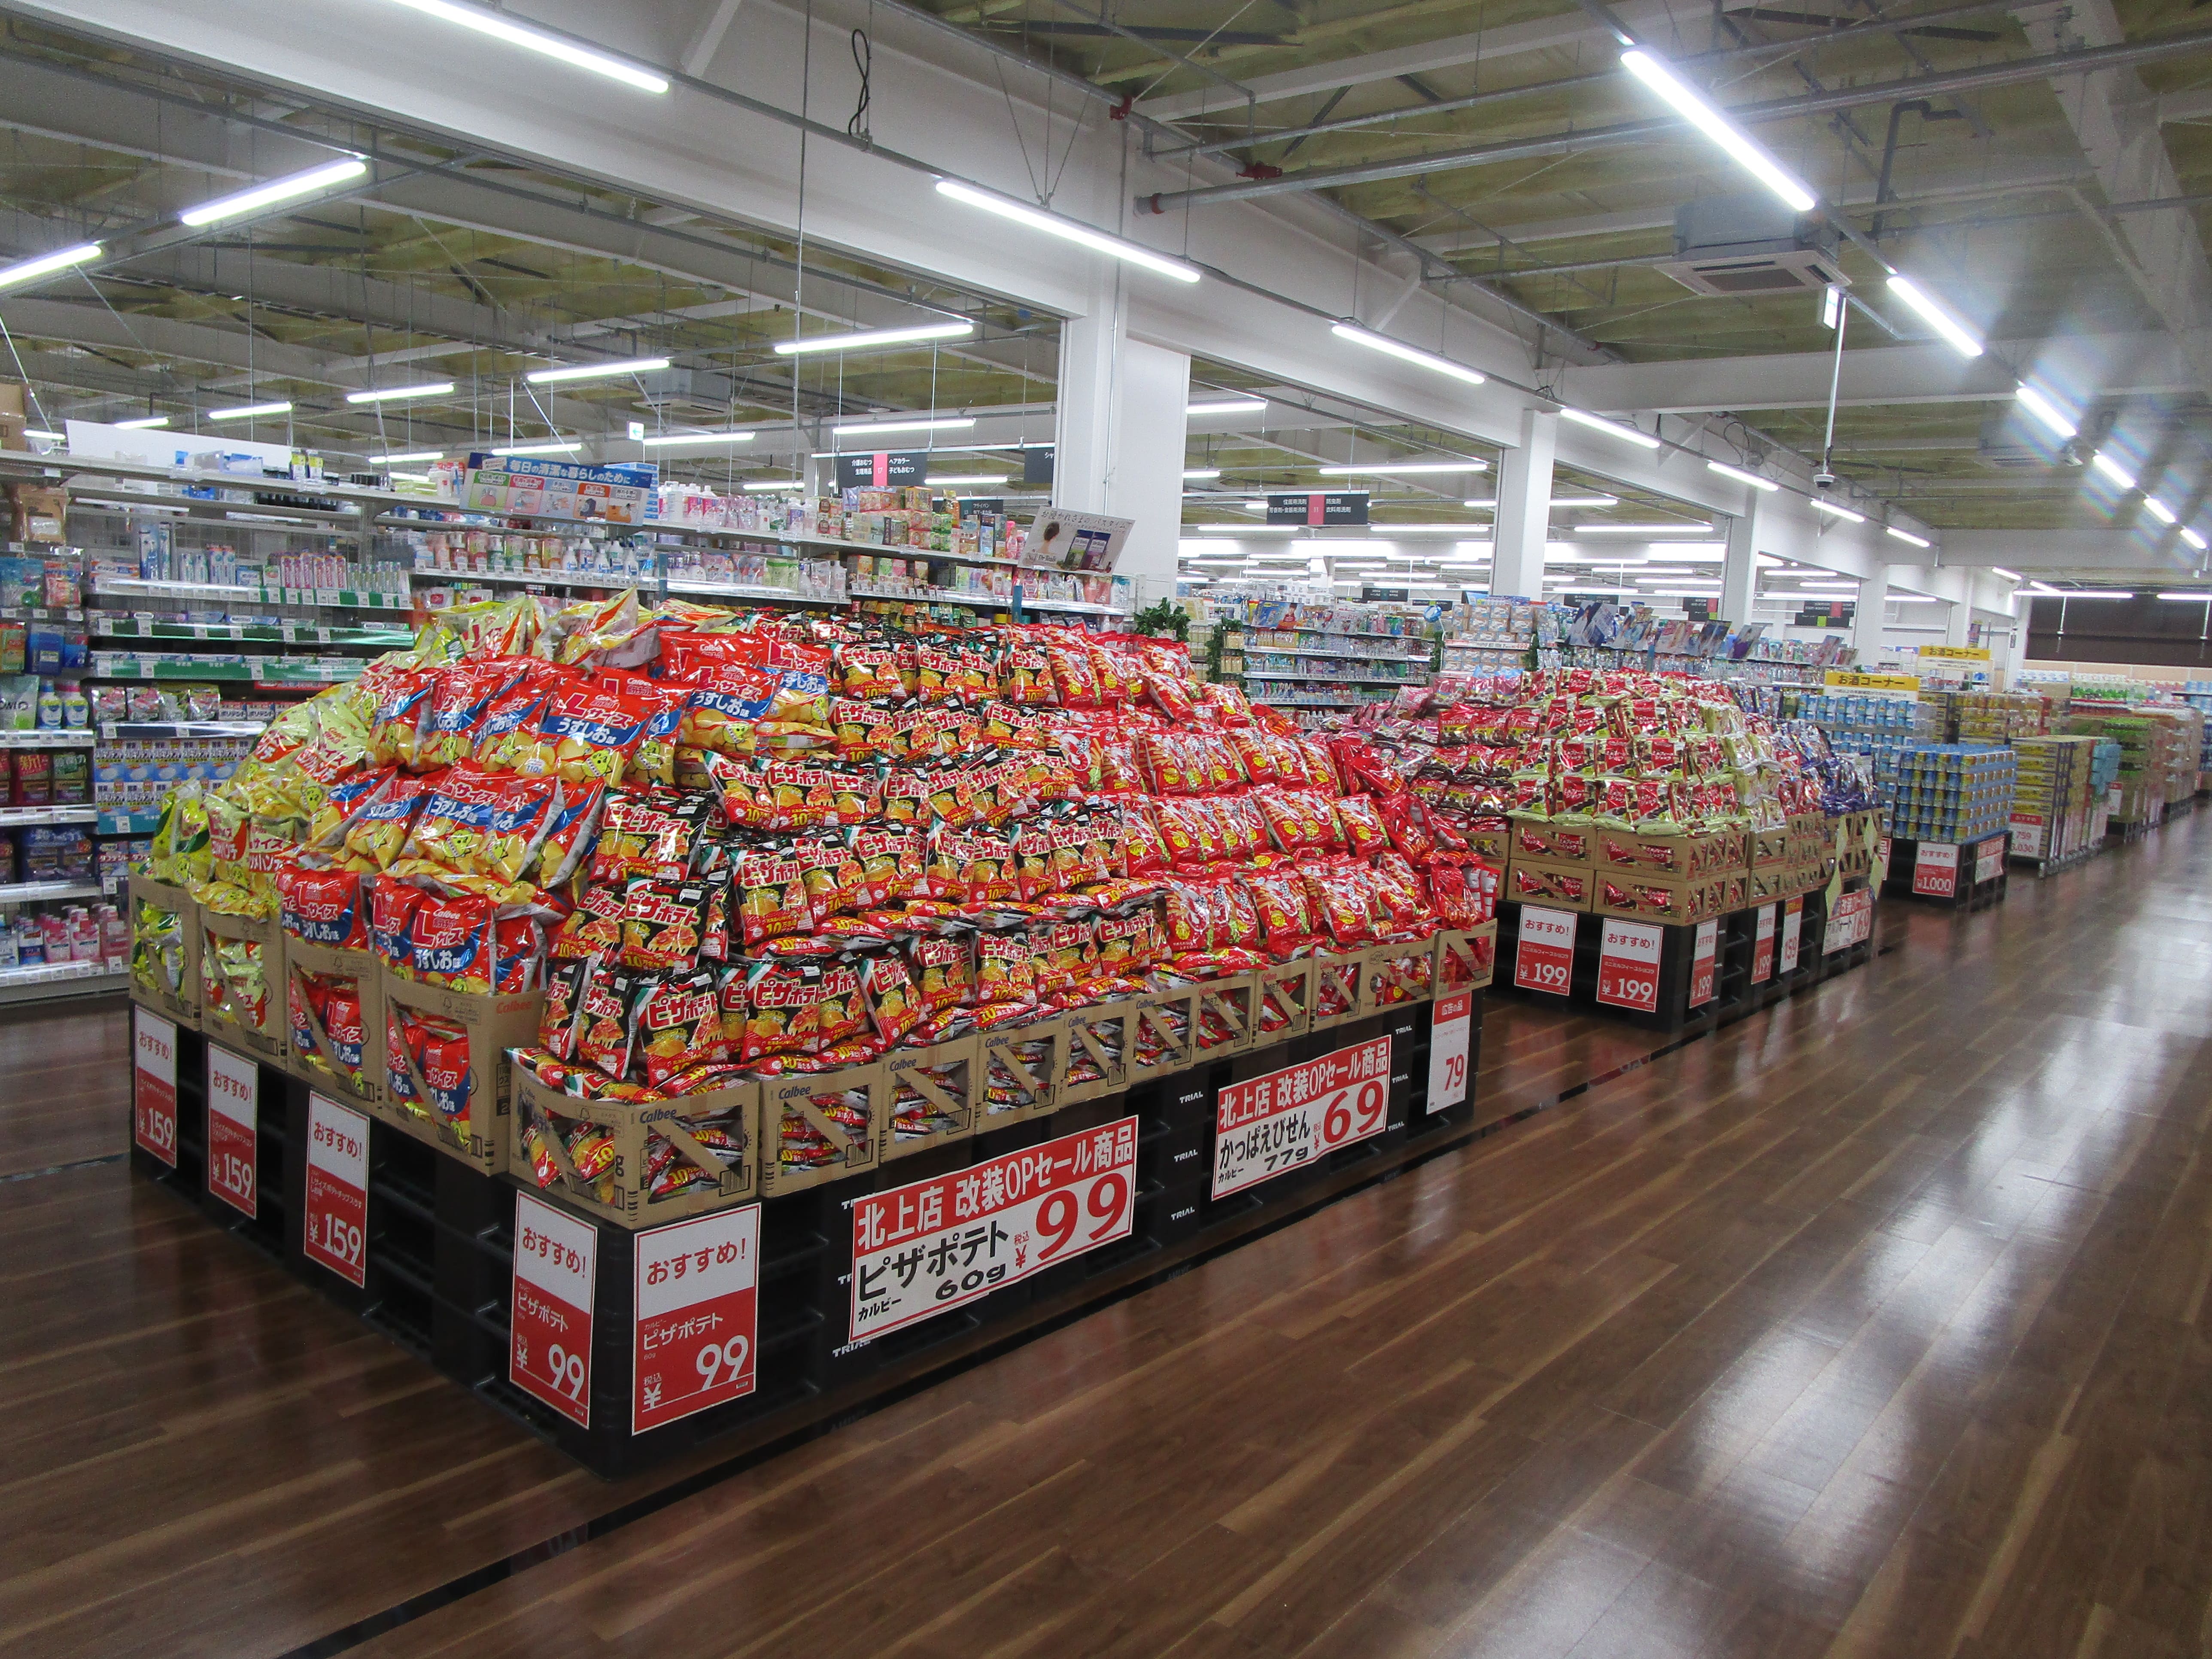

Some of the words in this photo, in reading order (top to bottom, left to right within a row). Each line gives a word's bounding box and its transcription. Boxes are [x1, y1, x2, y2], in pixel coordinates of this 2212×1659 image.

[889, 466, 915, 474] 子どもおむつ
[1839, 675, 1905, 687] お酒コーナー
[694, 691, 750, 718] うすしお味
[835, 702, 893, 726] ピザポテト
[987, 703, 1041, 727] ピザポテト
[556, 717, 617, 745] うすしお味
[625, 805, 693, 836] ピザポテト
[433, 908, 461, 919] Calbee
[625, 890, 702, 928] ピザポテト
[1525, 919, 1570, 936] おすすめ!
[1607, 933, 1655, 950] おすすめ!
[415, 948, 462, 970] うすしお味
[1534, 963, 1567, 986] 199
[1617, 978, 1653, 1002] 199
[496, 1000, 533, 1015] Calbee
[647, 990, 718, 1030] ピザポテト
[1136, 998, 1156, 1010] Calbee
[1442, 1000, 1463, 1015] 広告の品
[1068, 1015, 1086, 1028] Calbee
[1395, 1025, 1413, 1035] TRIAL
[984, 1036, 1009, 1048] Calbee
[889, 1057, 917, 1072] Calbee
[1444, 1054, 1464, 1091] 79
[213, 1070, 252, 1103] おすすめ!
[1220, 1082, 1271, 1129] 北上店
[1277, 1042, 1390, 1106] 改装OPセール商品
[1392, 1073, 1409, 1083] TRIAL
[778, 1085, 811, 1100] Calbee
[1179, 1091, 1204, 1104] TRIAL
[639, 1107, 677, 1124] Calbee
[1314, 1134, 1320, 1151] ¥
[1323, 1080, 1383, 1143] 69
[1388, 1121, 1405, 1132] TRIAL
[148, 1107, 172, 1150] 159
[1219, 1110, 1311, 1170] かっぱえびせん
[314, 1121, 362, 1161] おすすめ!
[1173, 1148, 1199, 1163] TRIAL
[1263, 1148, 1308, 1172] 77g
[224, 1152, 252, 1199] 159
[858, 1186, 945, 1251] 北上店
[954, 1124, 1134, 1218] 改装OPセール商品
[1218, 1167, 1244, 1184] カルビー
[1015, 1245, 1027, 1269] ¥
[1035, 1171, 1128, 1261] 99
[1170, 1206, 1196, 1221] TRIAL
[324, 1213, 362, 1265] 159
[1014, 1231, 1030, 1246] 税込
[522, 1226, 587, 1279] おすすめ!
[647, 1237, 747, 1286] おすすめ!
[859, 1219, 1009, 1303] ピザポテト
[935, 1262, 1006, 1301] 60g
[517, 1291, 568, 1333] ピザポテト
[858, 1297, 902, 1322] カルビー
[643, 1312, 724, 1351] ピザポテト
[644, 1352, 656, 1361] 60g
[516, 1346, 529, 1369] ¥
[548, 1343, 585, 1401] 99
[643, 1386, 662, 1409] ¥
[696, 1334, 749, 1392] 99
[643, 1372, 662, 1386] 税込
